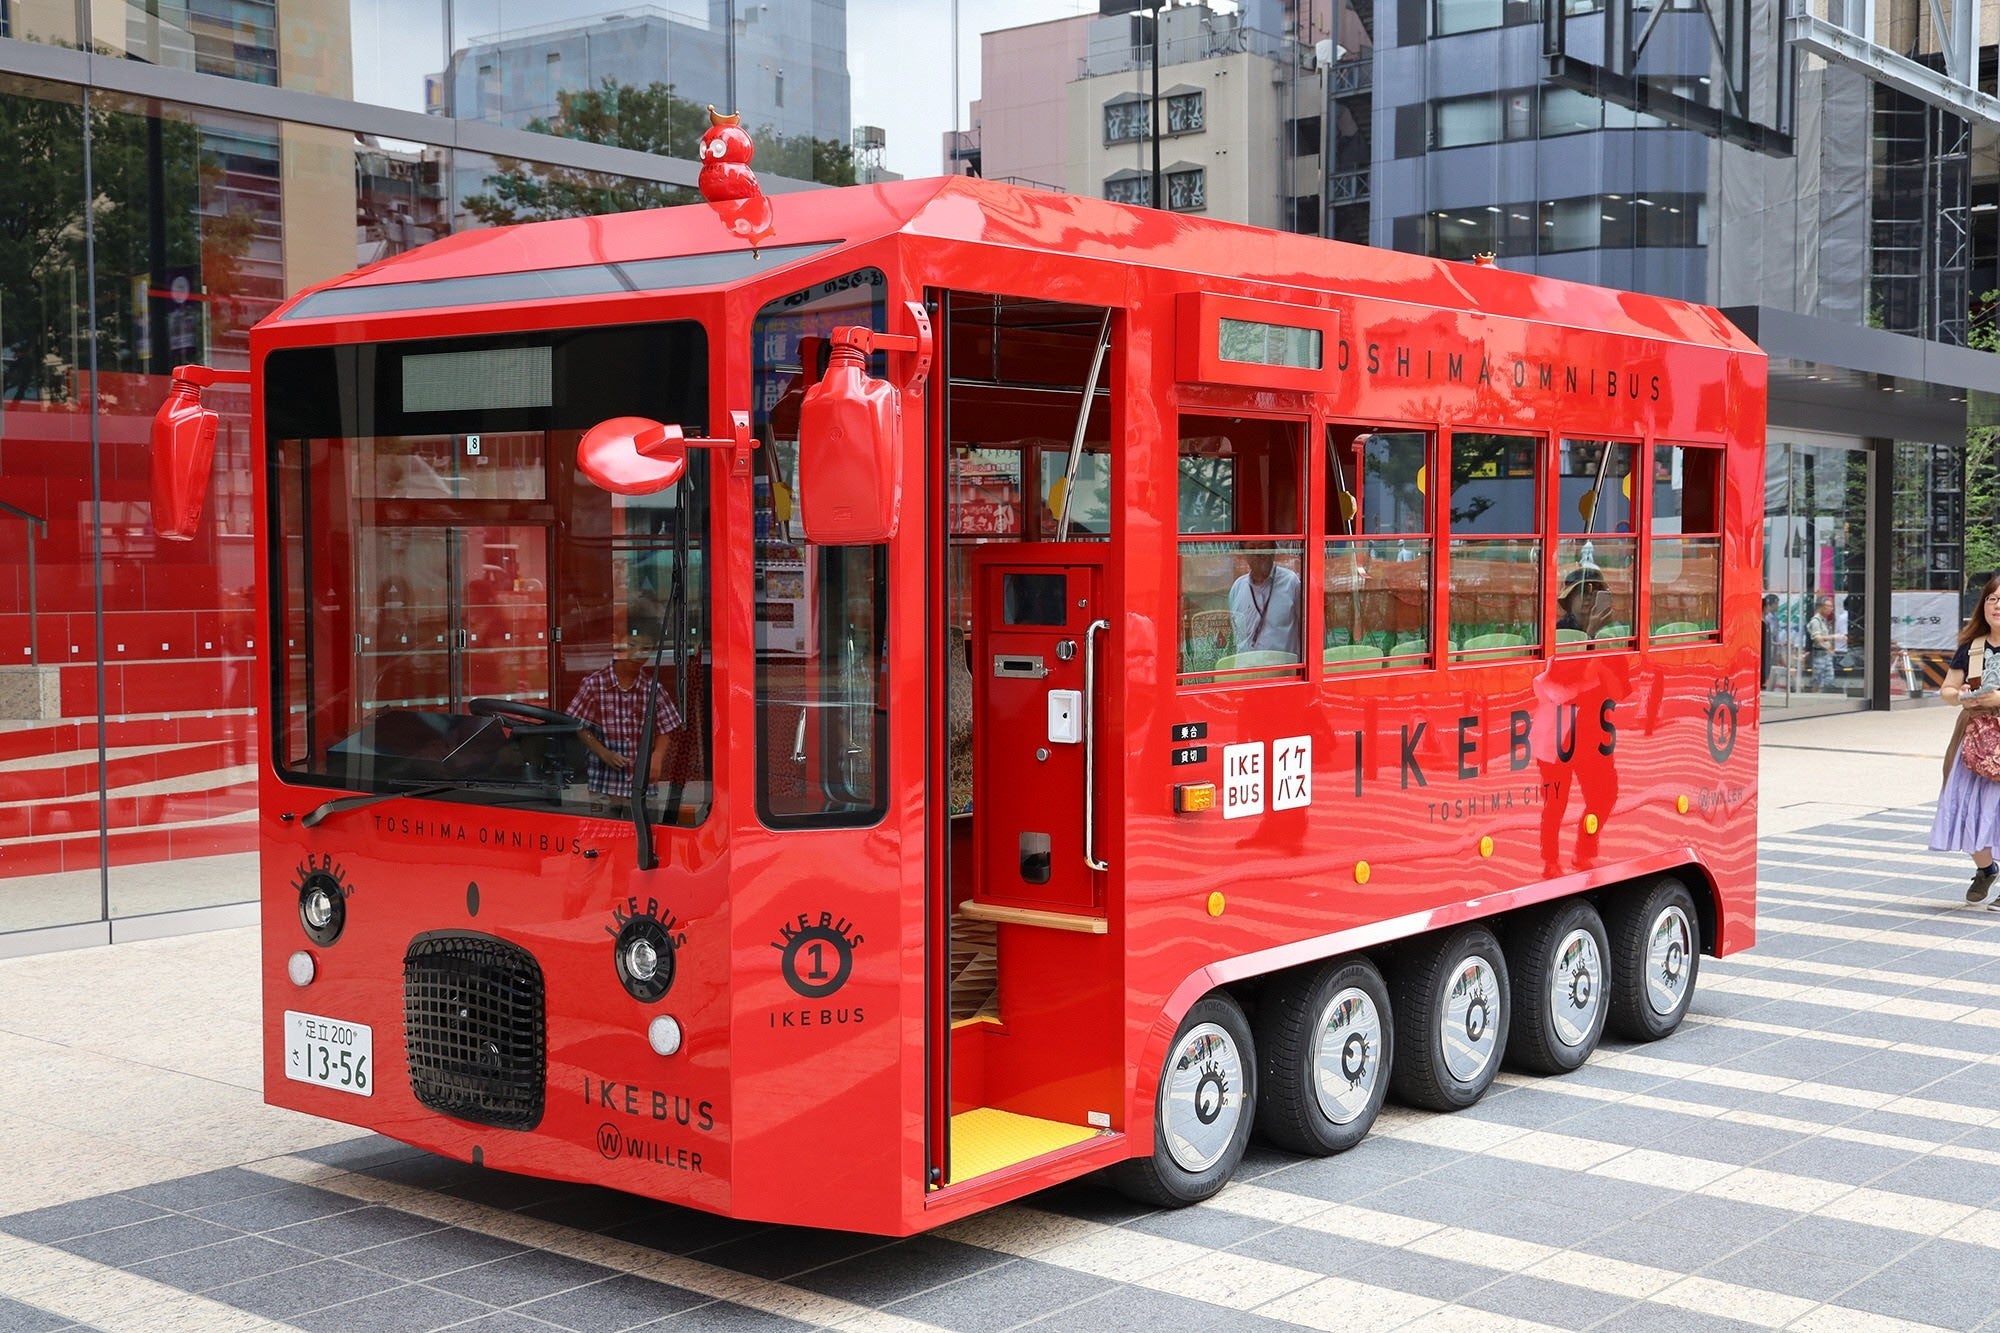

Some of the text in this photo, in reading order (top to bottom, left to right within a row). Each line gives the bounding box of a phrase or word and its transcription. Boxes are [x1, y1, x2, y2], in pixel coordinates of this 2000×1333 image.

[1338, 340, 1660, 401] OSHIMA OMNIBUS
[472, 437, 478, 449] 8
[1180, 725, 1198, 739] 乗合
[1180, 749, 1198, 763] 貸切
[1278, 745, 1306, 771] イケ
[1354, 698, 1617, 798] IKEBUS
[1230, 753, 1260, 777] IKE
[1228, 783, 1260, 807] BUS
[1277, 774, 1306, 801] バス
[1428, 781, 1561, 824] TOSHIMA CITY
[374, 815, 581, 855] TOSHIMA OMNIBUS
[807, 943, 829, 979] 1
[307, 1043, 367, 1089] 13-56
[626, 1136, 702, 1173] WILLER
